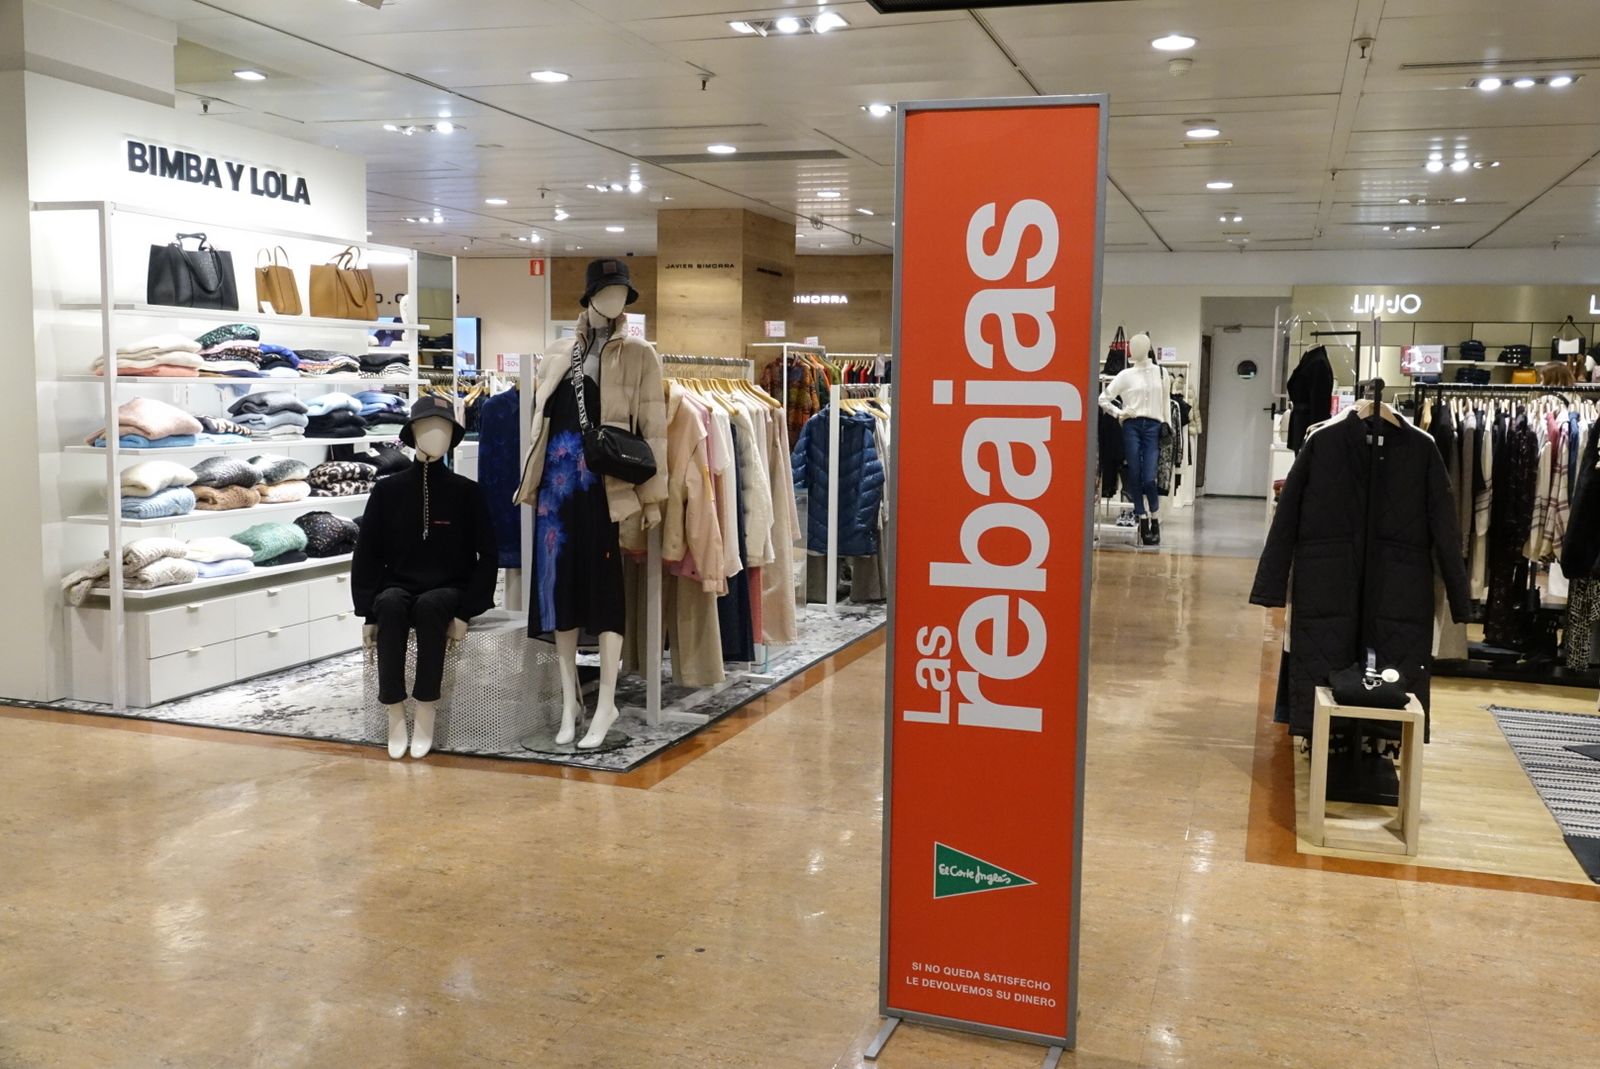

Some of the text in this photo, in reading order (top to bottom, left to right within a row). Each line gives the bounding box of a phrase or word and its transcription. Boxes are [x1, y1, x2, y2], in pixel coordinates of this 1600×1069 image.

[128, 140, 311, 205] BIMBA Y LOLA
[665, 262, 735, 270] JAVIER SIMORRA
[793, 294, 848, 305] IMORRA
[929, 198, 1083, 734] rebajas
[903, 625, 953, 724] Las
[938, 863, 1011, 885] El Corte Inglés
[906, 975, 1057, 1008] LE DEVOLVEMOS SU DINERO
[912, 961, 1051, 991] SI NO QUEDA SATISFECHO
